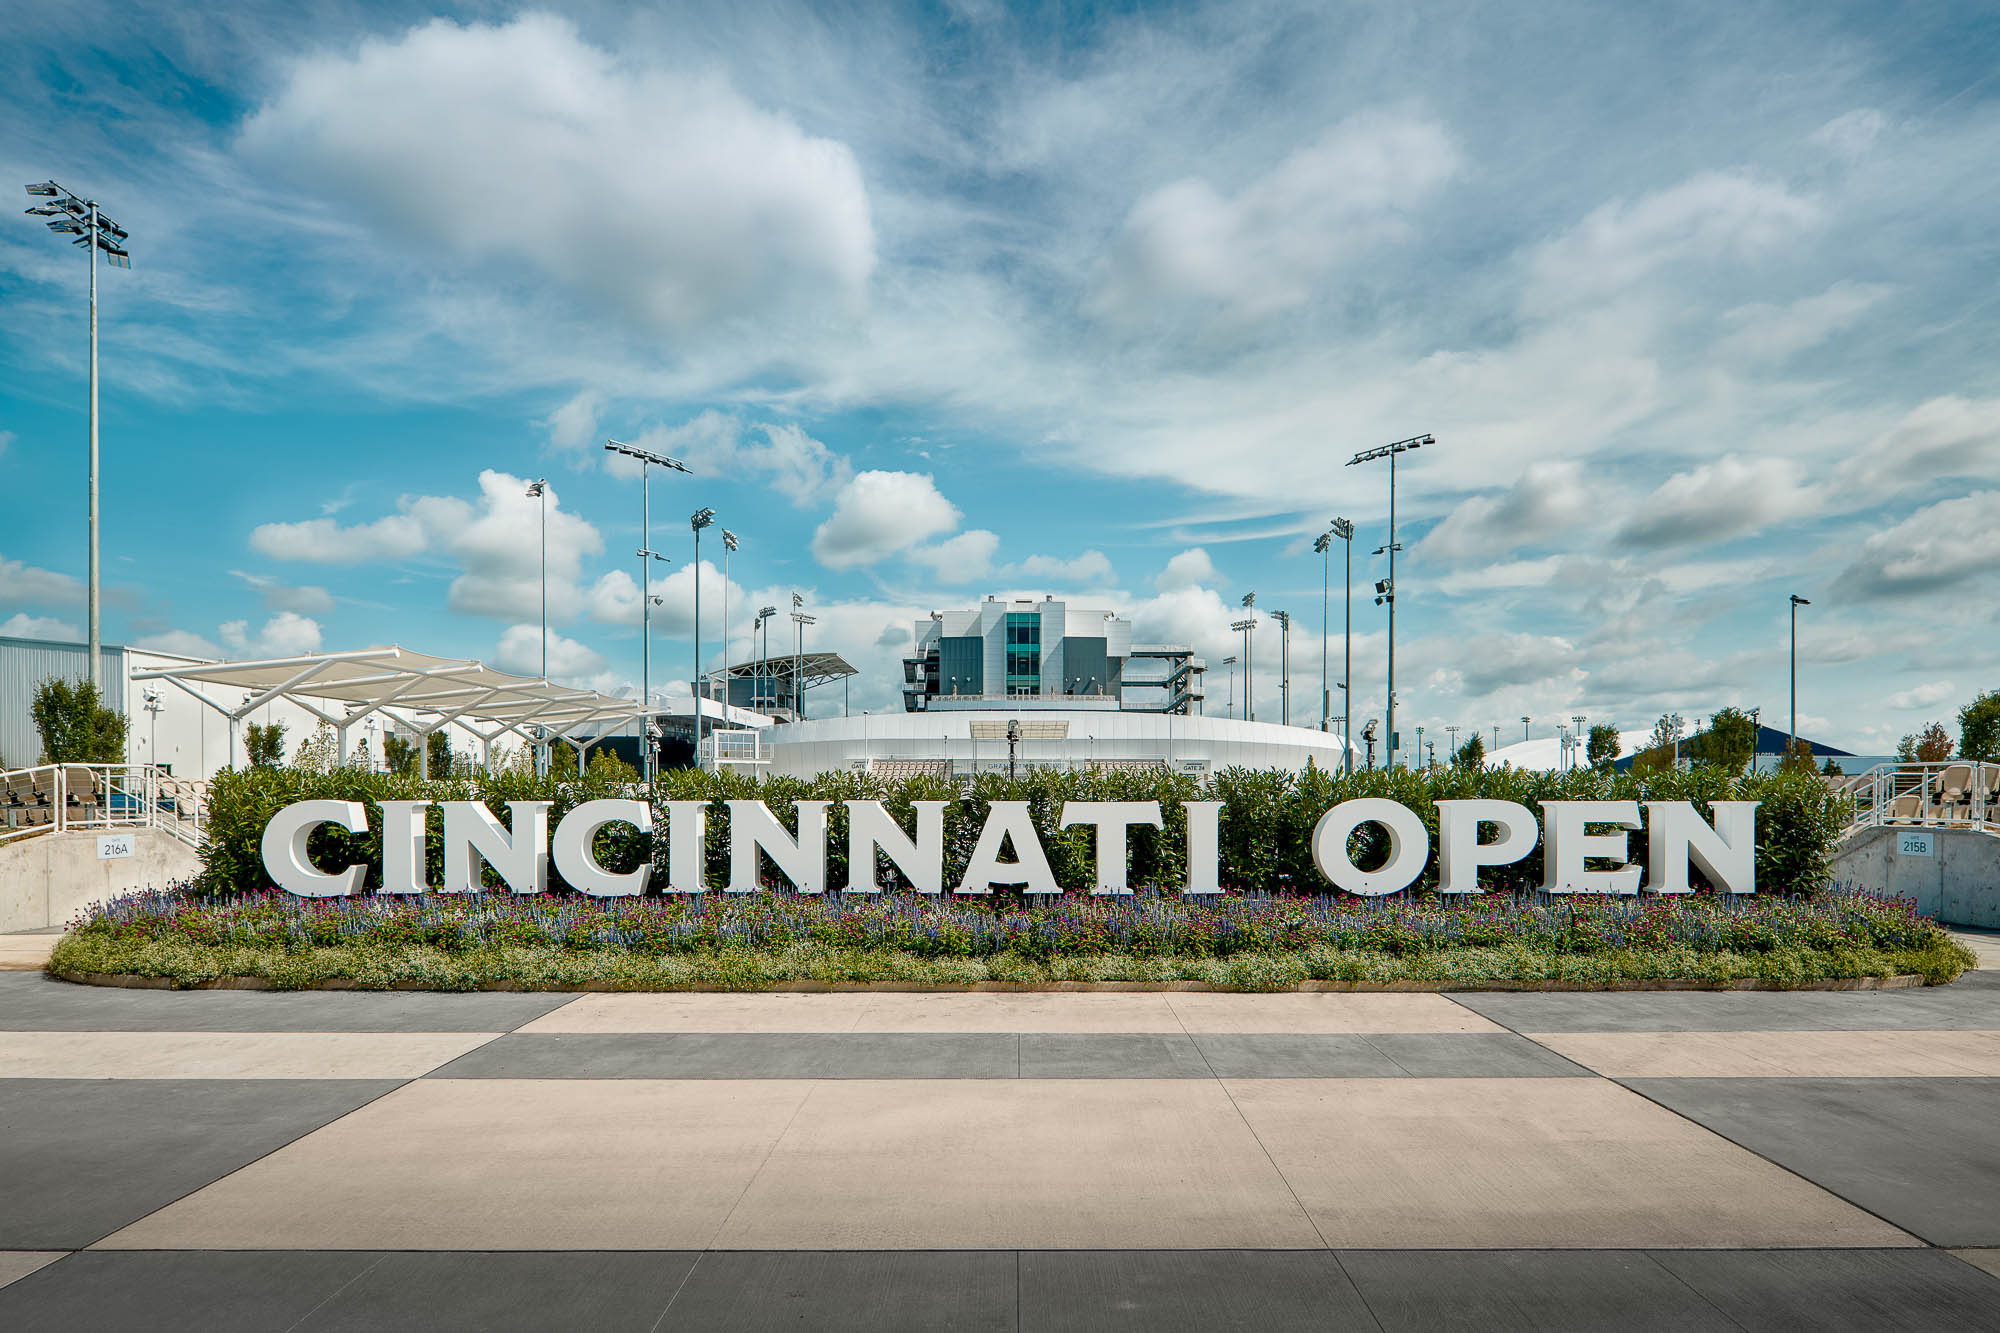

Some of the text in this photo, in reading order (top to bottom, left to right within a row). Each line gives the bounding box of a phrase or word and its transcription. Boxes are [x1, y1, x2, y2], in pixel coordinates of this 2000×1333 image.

[104, 844, 128, 855] 216A
[261, 797, 1761, 897] CINCINNATI OPEN
[1903, 841, 1926, 852] 215B
